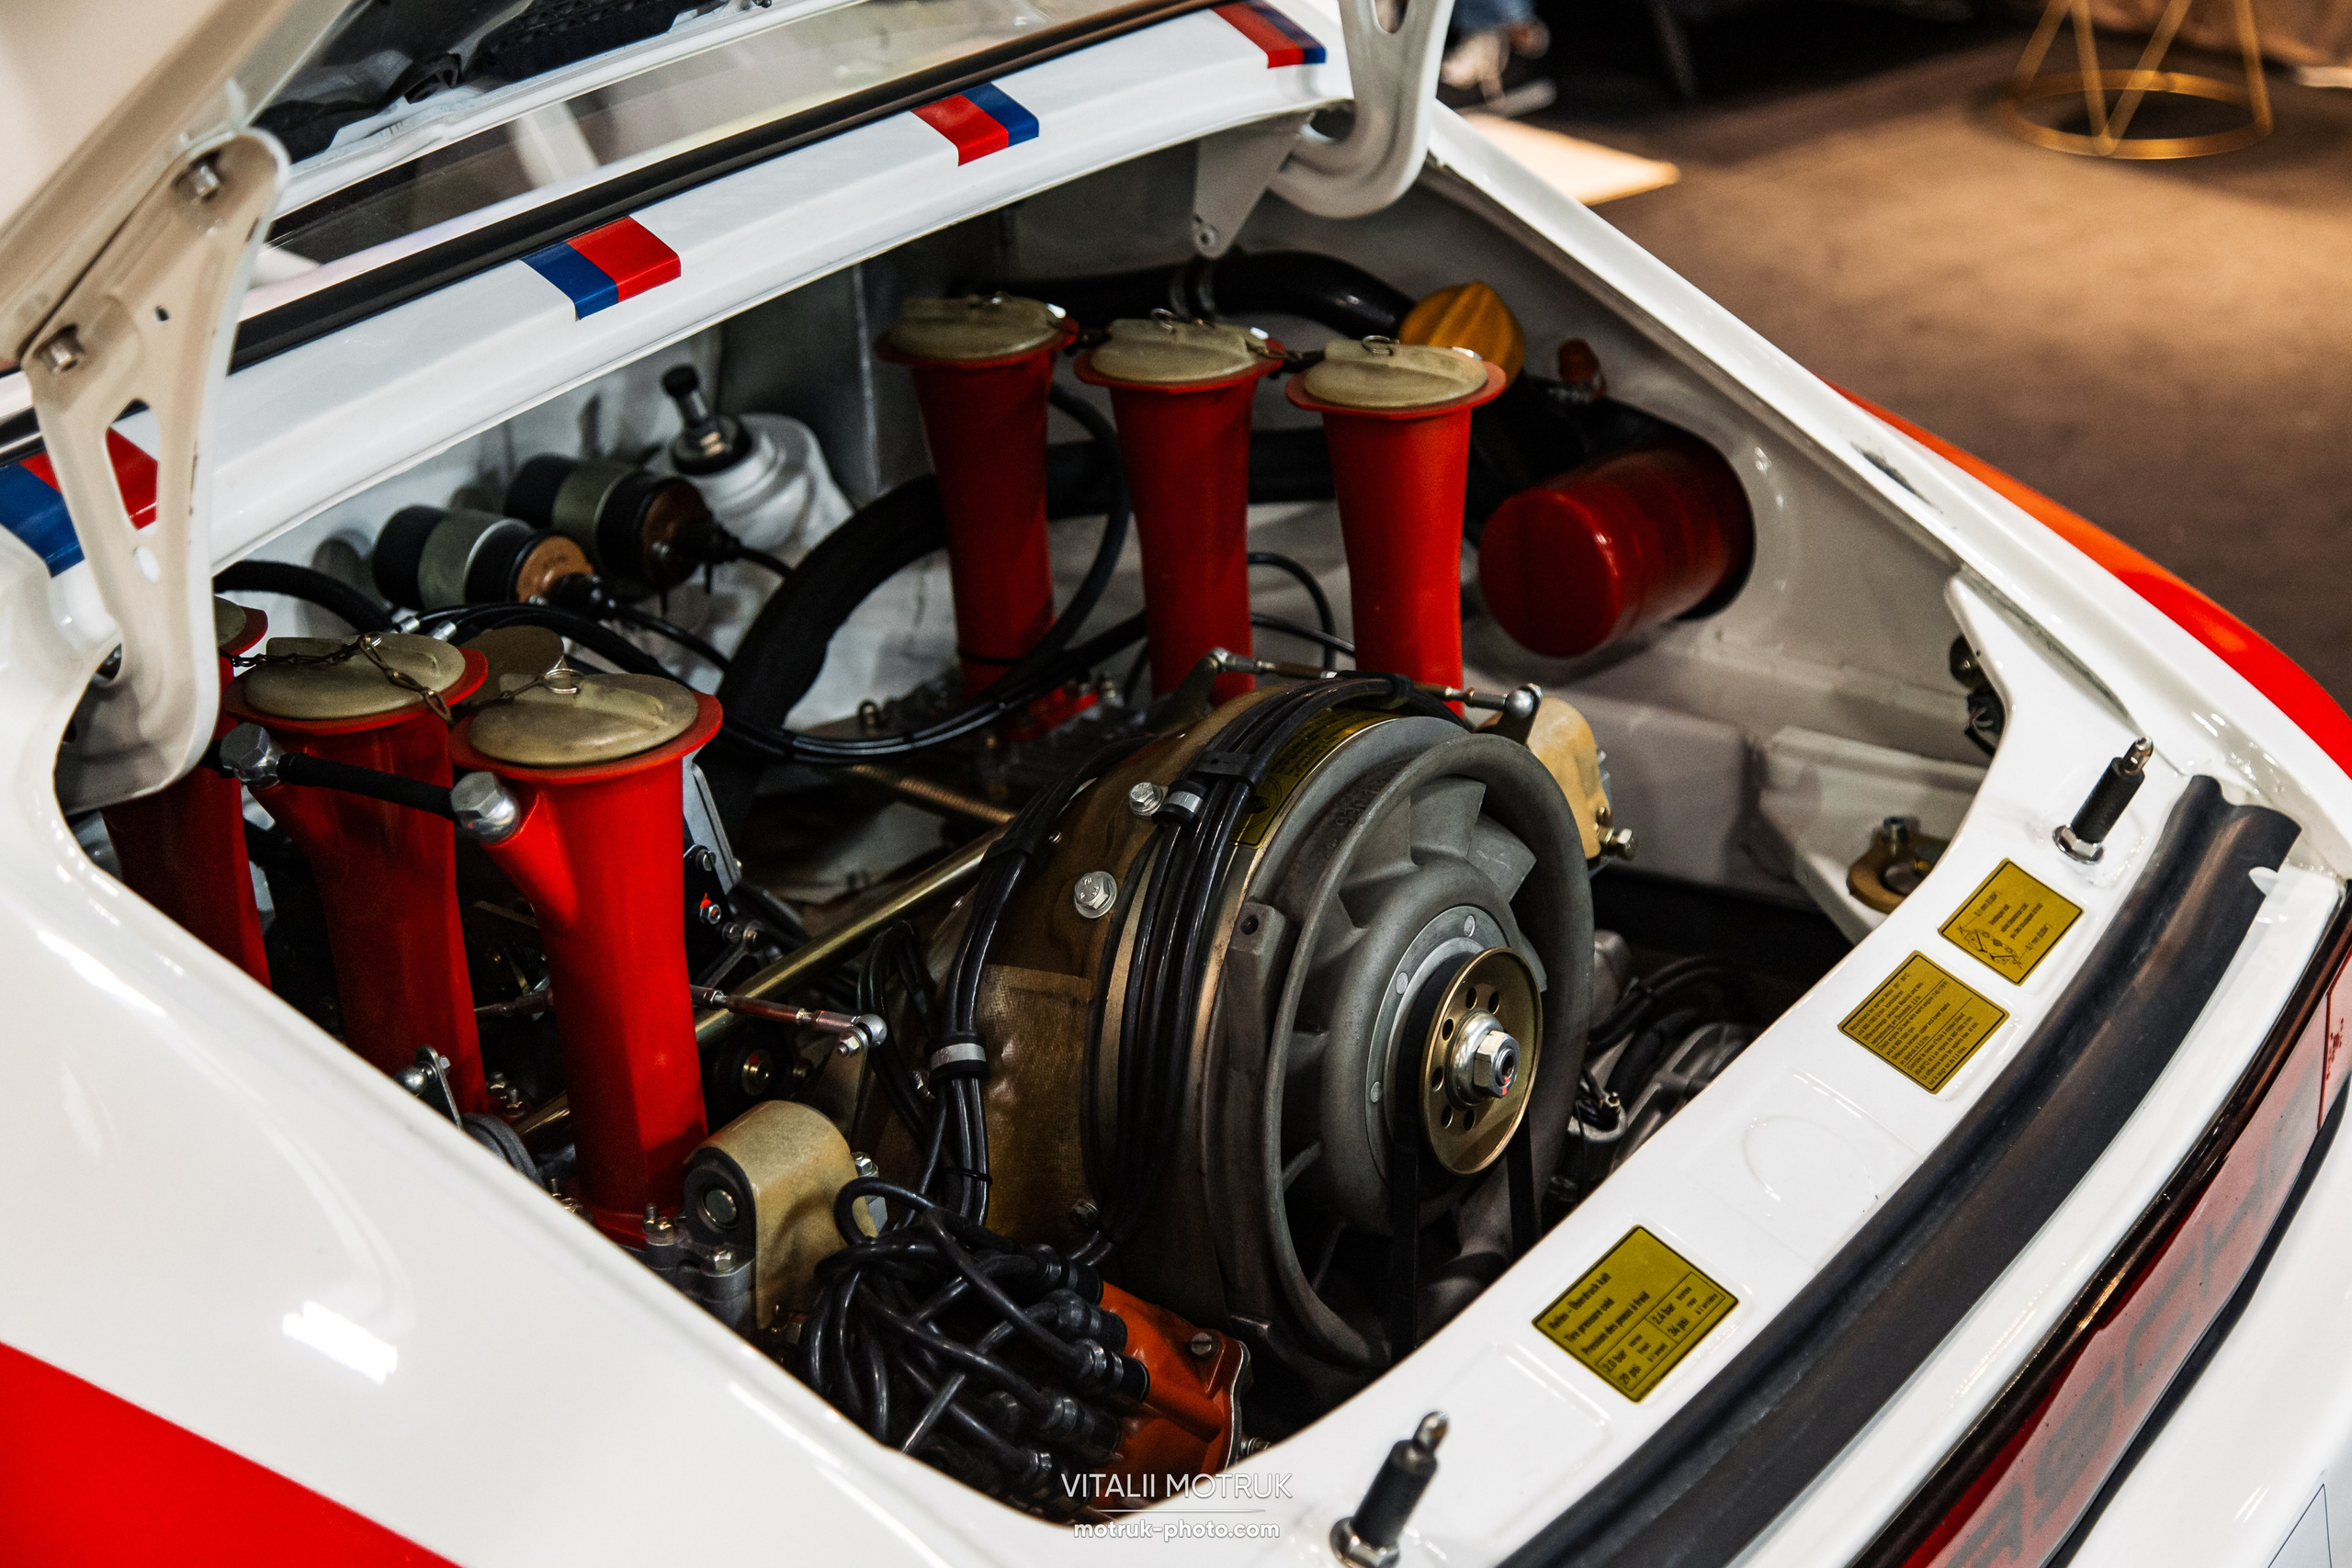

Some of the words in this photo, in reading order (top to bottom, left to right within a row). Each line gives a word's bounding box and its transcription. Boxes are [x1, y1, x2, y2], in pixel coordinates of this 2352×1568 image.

[1659, 1301, 1677, 1315] bar
[1563, 1328, 1580, 1343] Tire
[1576, 1308, 1605, 1335] pressure
[1597, 1296, 1615, 1312] cold
[1674, 1315, 1692, 1331] psi
[1579, 1330, 1609, 1356] Pression
[1611, 1348, 1628, 1363] bar
